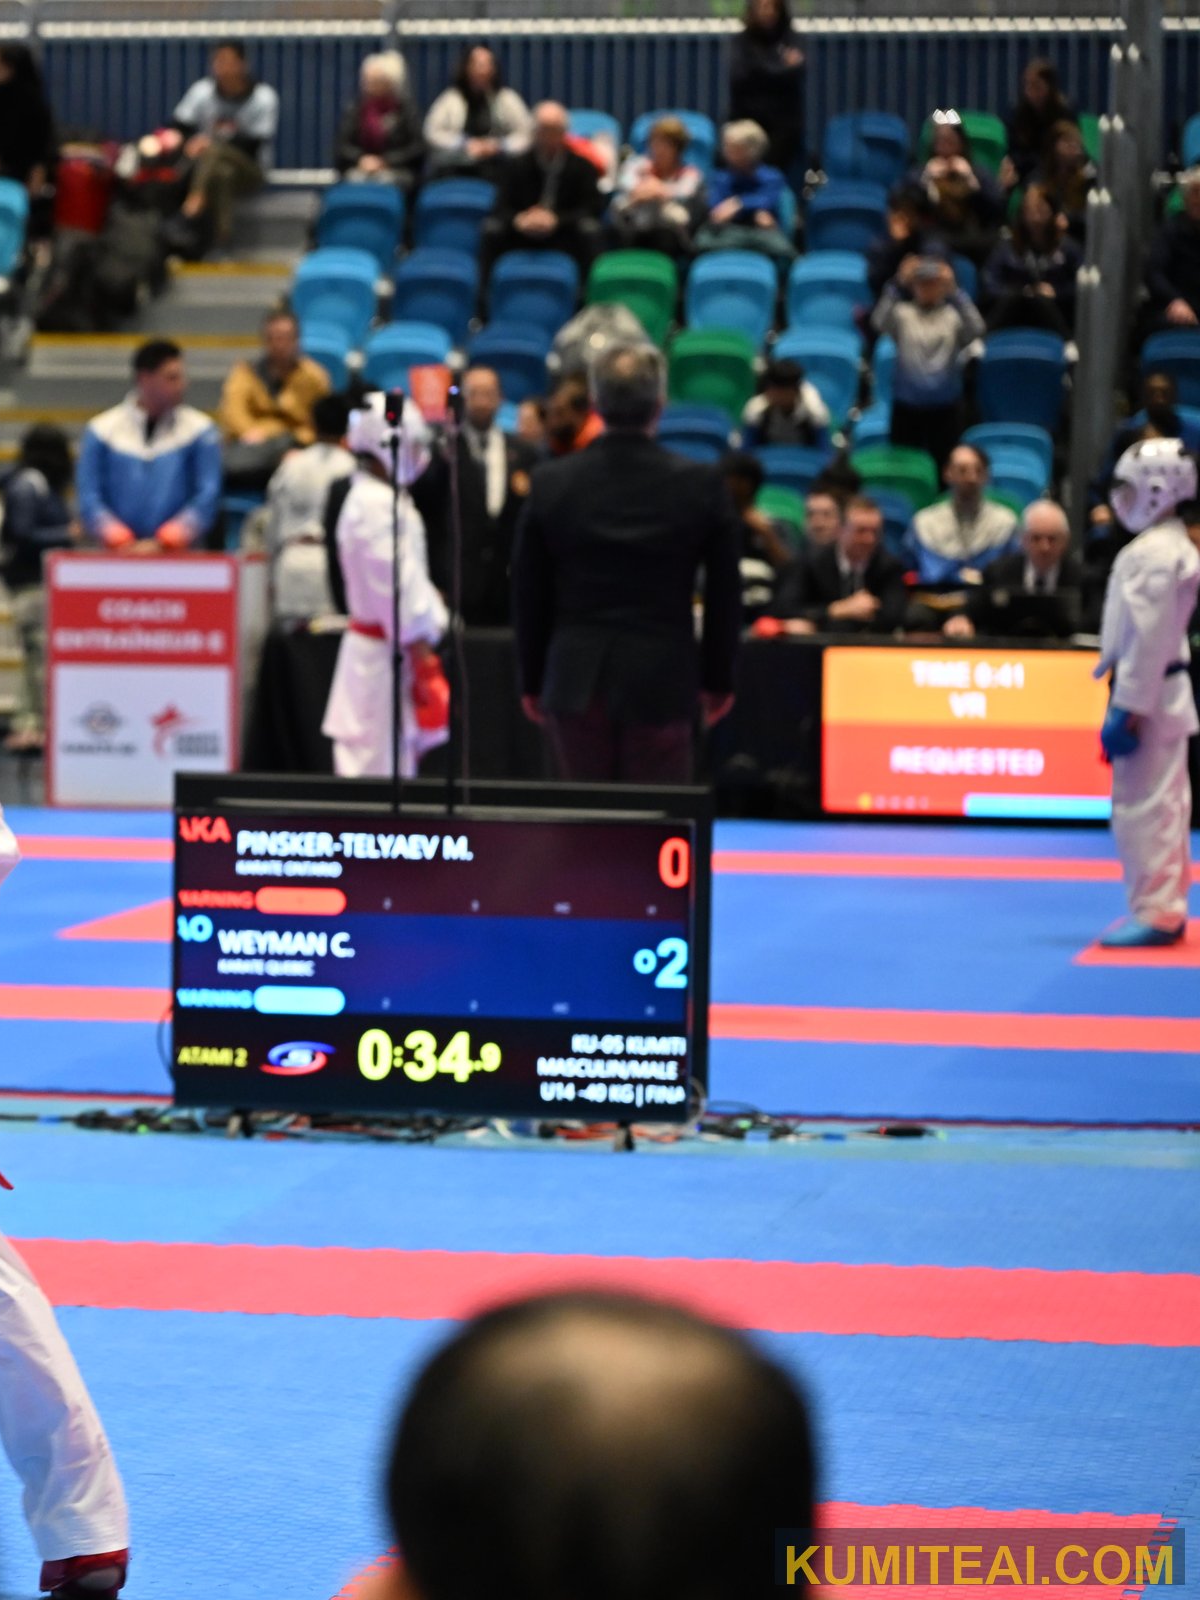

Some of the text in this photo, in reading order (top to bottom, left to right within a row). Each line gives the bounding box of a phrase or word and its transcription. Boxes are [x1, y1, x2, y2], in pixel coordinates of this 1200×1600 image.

[890, 746, 1045, 776] REQUESTED
[236, 830, 475, 861] PINSKER-TELYAEV M.
[658, 837, 690, 889] 0
[217, 929, 356, 959] WEYMAN C.
[234, 1047, 248, 1068] 2
